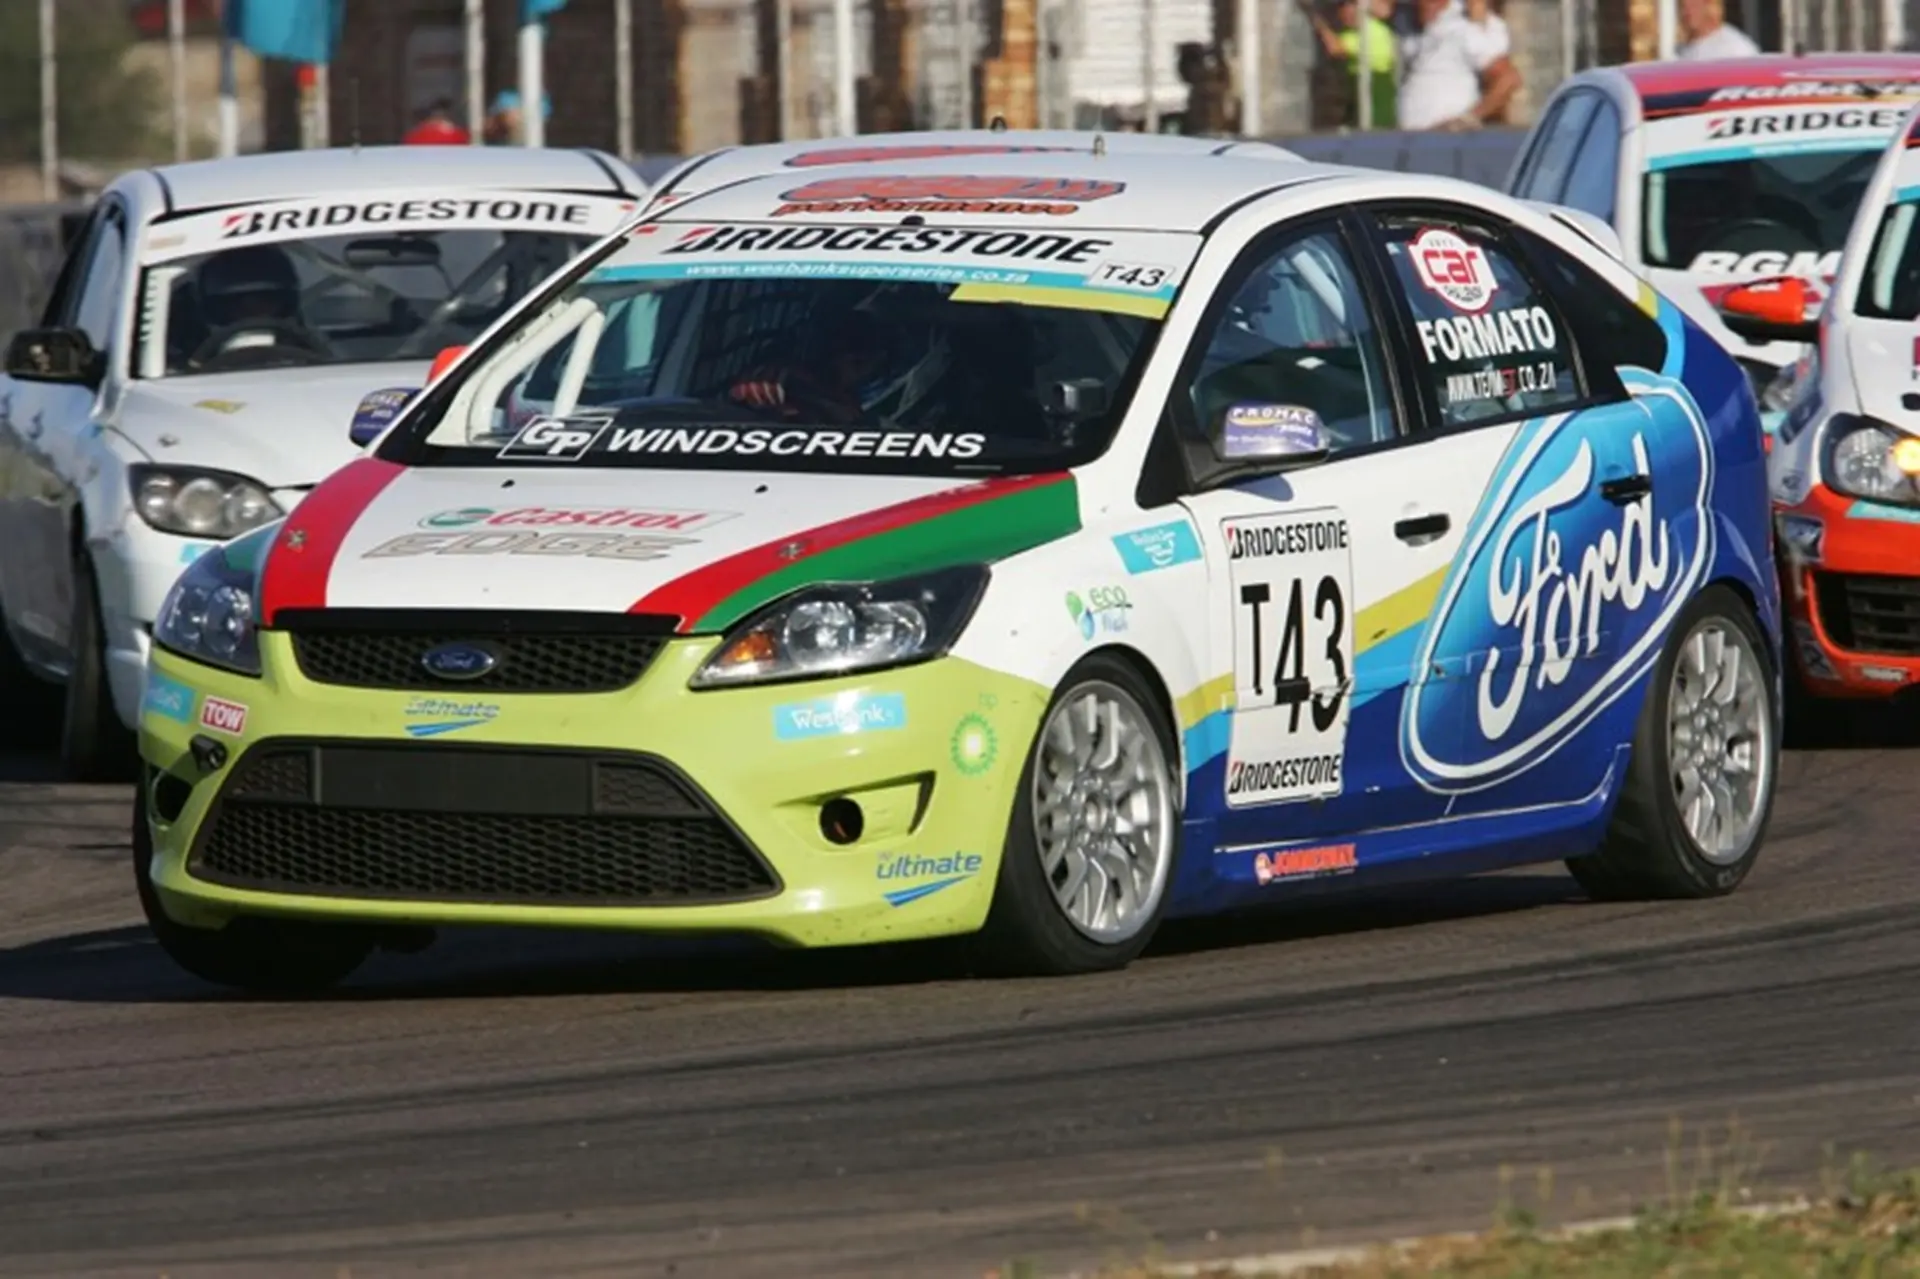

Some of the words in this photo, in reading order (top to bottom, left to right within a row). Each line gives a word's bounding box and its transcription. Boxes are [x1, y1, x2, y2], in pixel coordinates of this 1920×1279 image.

[222, 199, 591, 240] BRIDGESTONE
[659, 226, 1113, 263] BRIDGESTONE
[1104, 264, 1165, 287] T43
[1422, 250, 1478, 284] car
[1416, 306, 1556, 363] FORMATO
[521, 419, 592, 455] GP
[606, 427, 987, 458] WINDSCREENS
[487, 507, 707, 531] Castrol
[360, 530, 703, 561] EDGE
[1226, 519, 1348, 560] BRIDGESTONE
[1477, 431, 1668, 741] Ford
[1240, 574, 1348, 734] T43
[205, 700, 245, 731] TOW
[1228, 754, 1342, 794] BRIDGESTONE
[876, 850, 982, 879] ultimate
